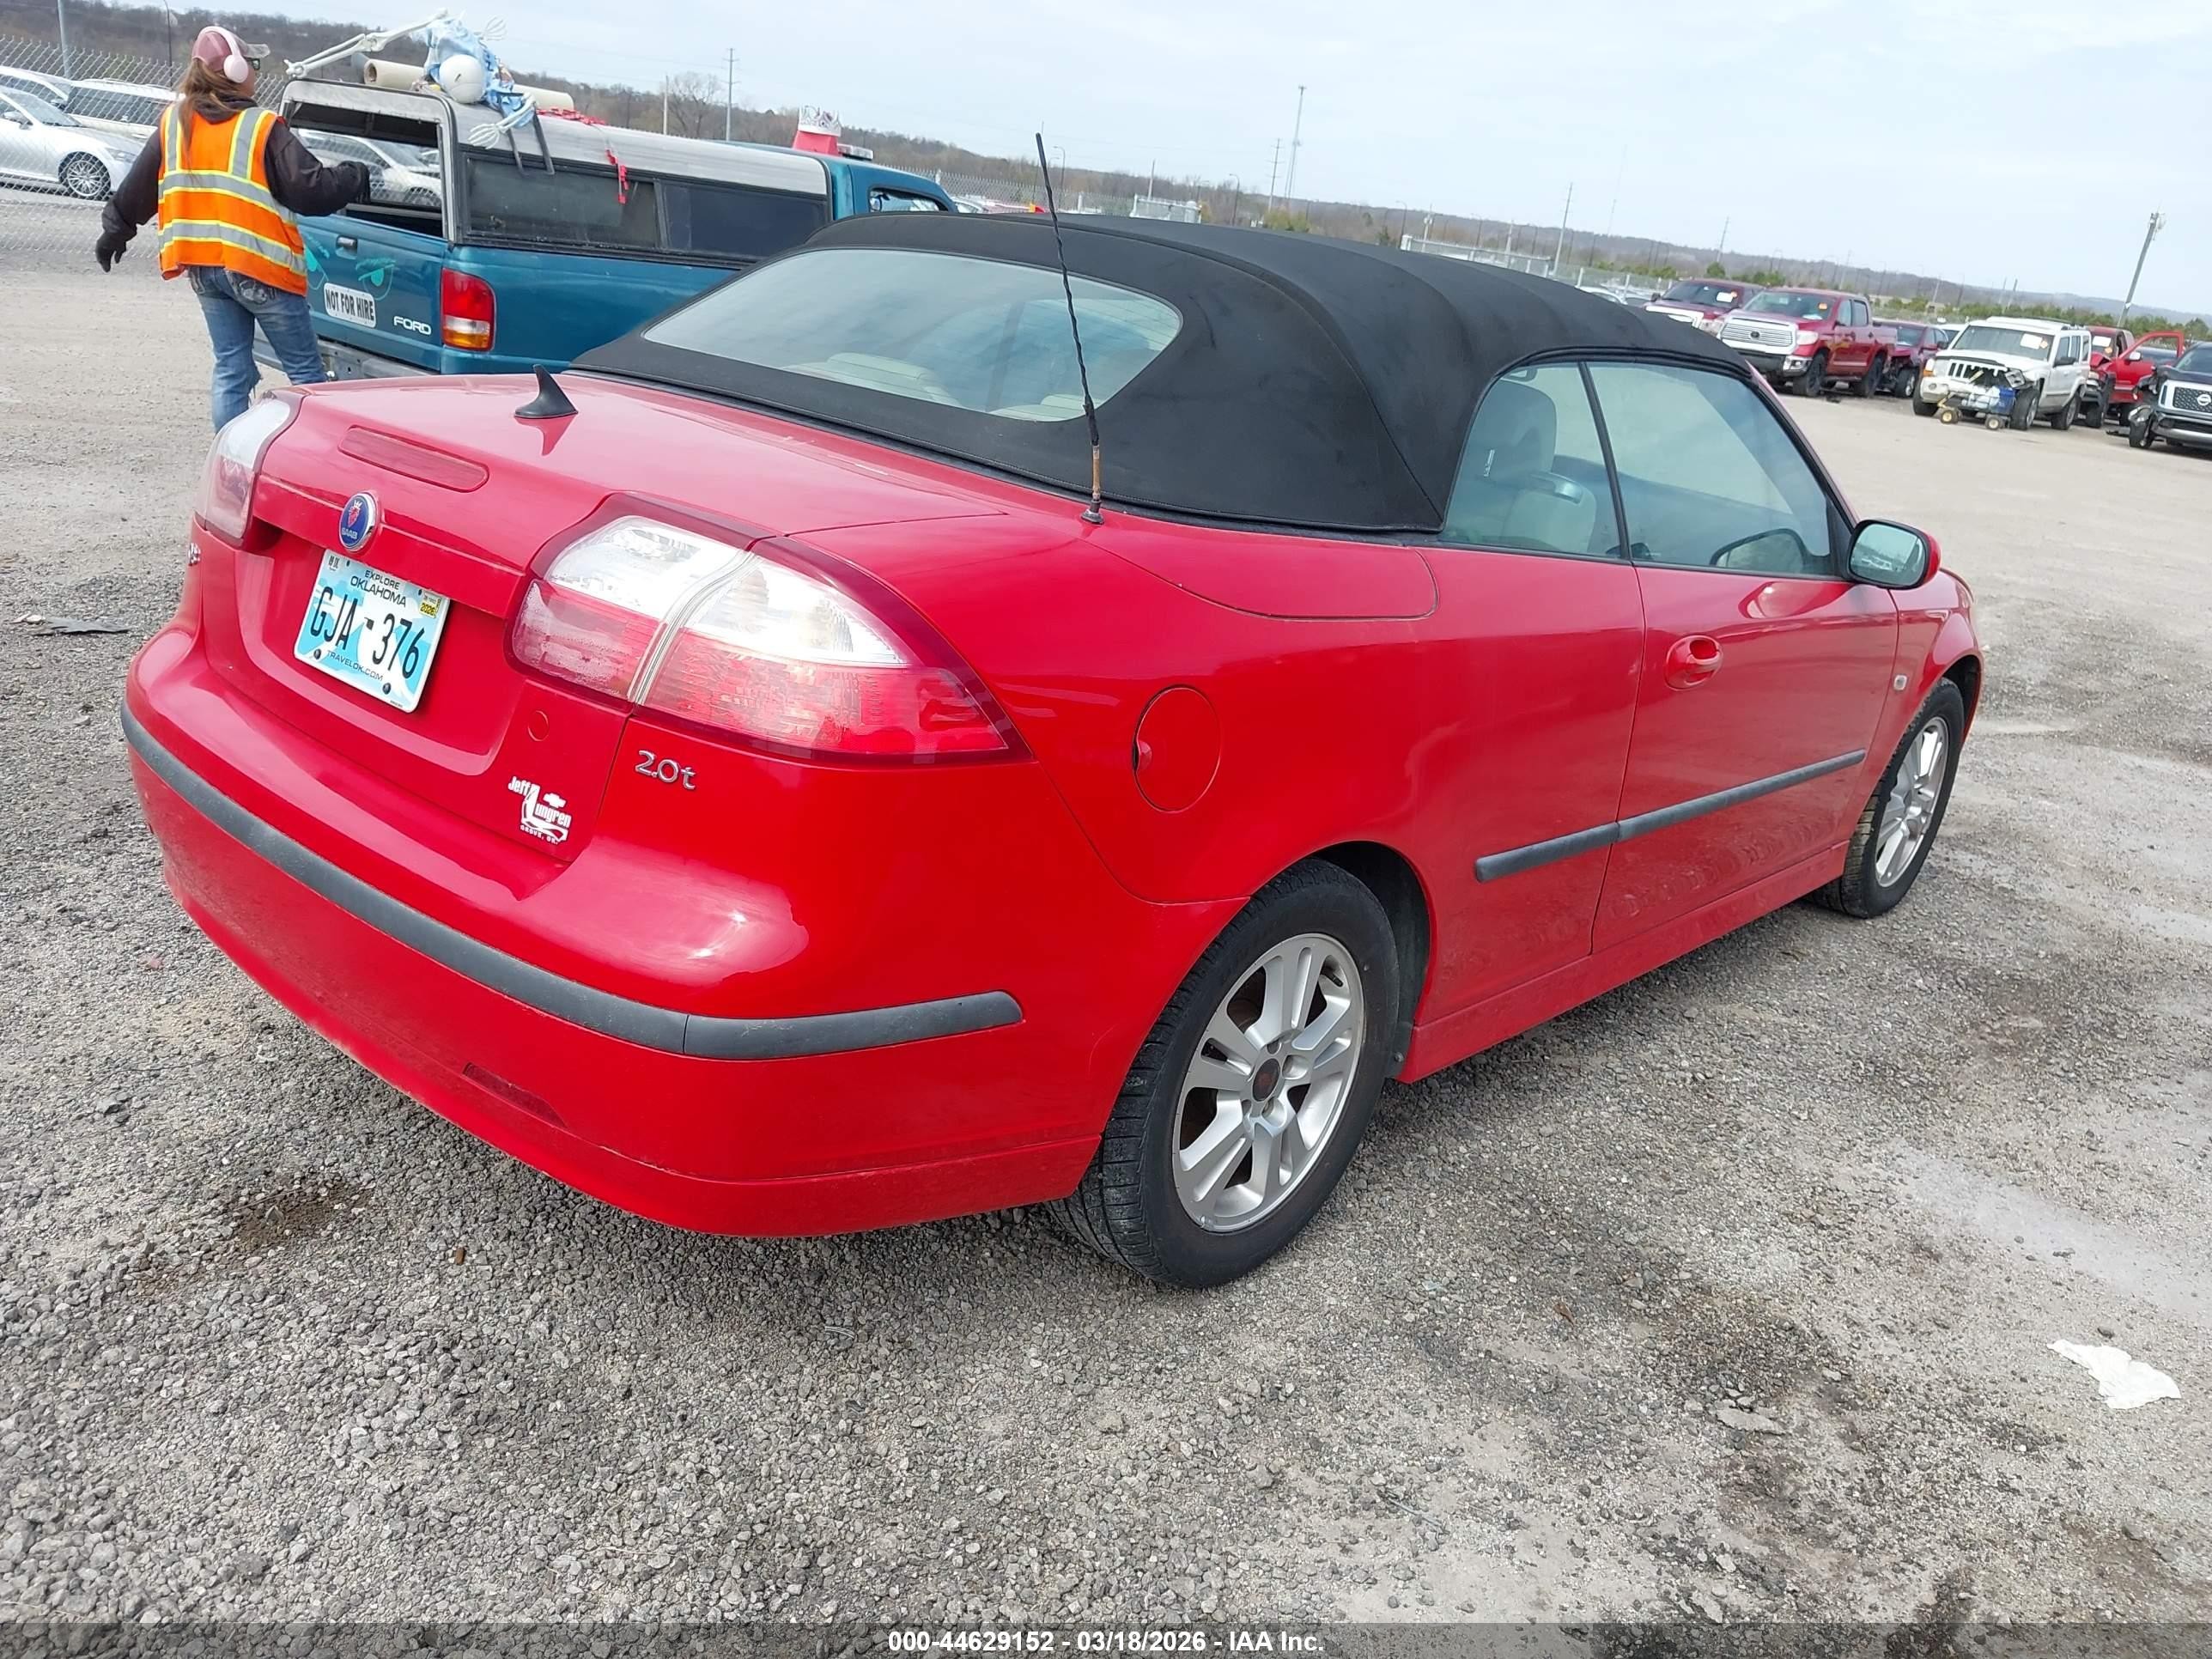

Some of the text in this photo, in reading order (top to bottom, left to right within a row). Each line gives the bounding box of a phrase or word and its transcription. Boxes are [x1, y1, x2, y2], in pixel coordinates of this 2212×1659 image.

[325, 289, 374, 321] NOT FOR HIRE
[393, 315, 432, 335] FORD
[350, 575, 406, 608] OKLAHOMA
[364, 569, 400, 590] EXPLORE
[310, 586, 425, 678] GJA 376
[327, 649, 384, 681] TRAVELOK.COM
[507, 775, 531, 796] Jeff
[635, 750, 696, 790] 2.0t
